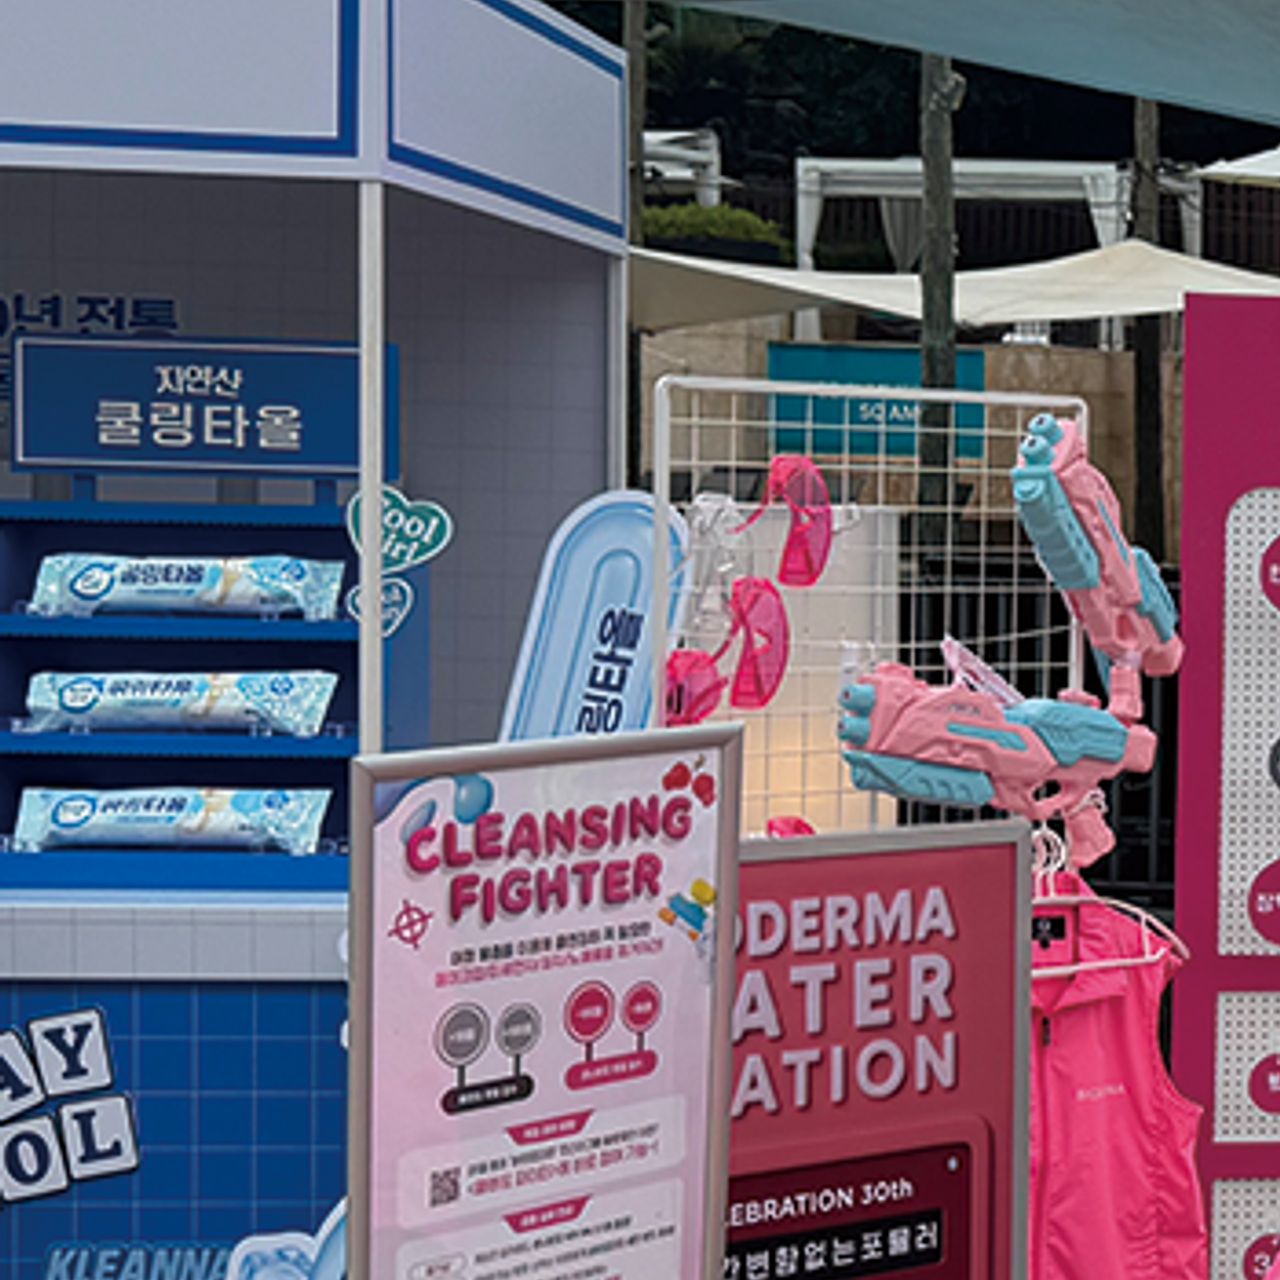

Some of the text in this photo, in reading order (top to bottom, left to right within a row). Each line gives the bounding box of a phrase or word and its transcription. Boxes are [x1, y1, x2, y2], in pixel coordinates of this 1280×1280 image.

[0, 293, 62, 332] 년
[155, 365, 243, 398] 자연산
[95, 400, 302, 450] 쿨링타올
[382, 499, 439, 543] ool
[381, 533, 421, 563] irl
[406, 793, 693, 873] CLEANSING
[448, 853, 664, 923] FIGHTER
[734, 885, 957, 957] DERMA
[724, 1178, 915, 1227] EBRATION 30th
